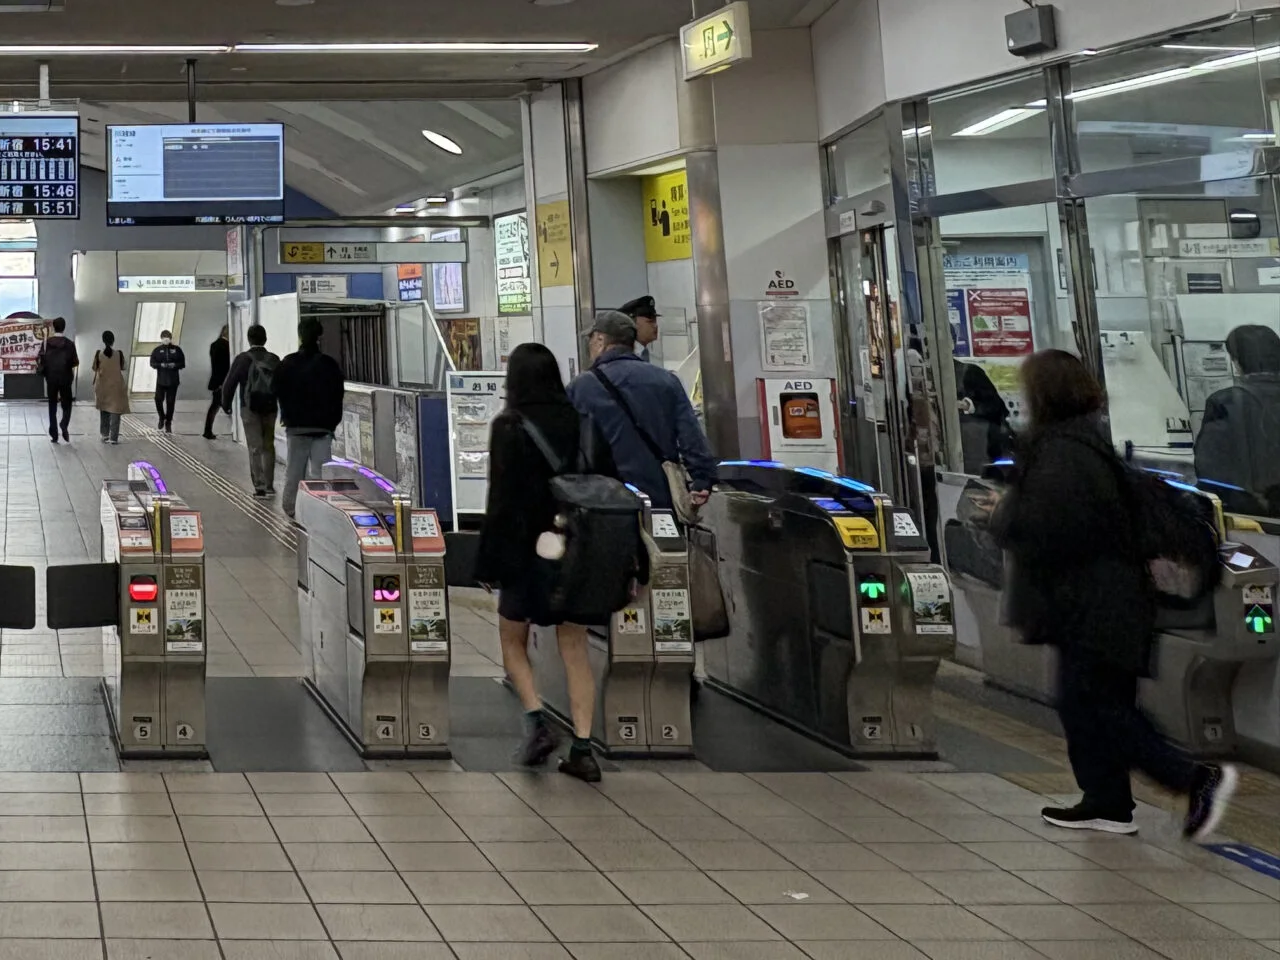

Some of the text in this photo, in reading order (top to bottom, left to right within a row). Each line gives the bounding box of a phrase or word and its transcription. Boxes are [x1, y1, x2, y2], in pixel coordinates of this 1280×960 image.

[34, 138, 72, 151] 15:41
[34, 185, 74, 197] 15:46
[34, 202, 73, 214] 15:51
[768, 279, 794, 289] AED
[784, 381, 813, 391] AED
